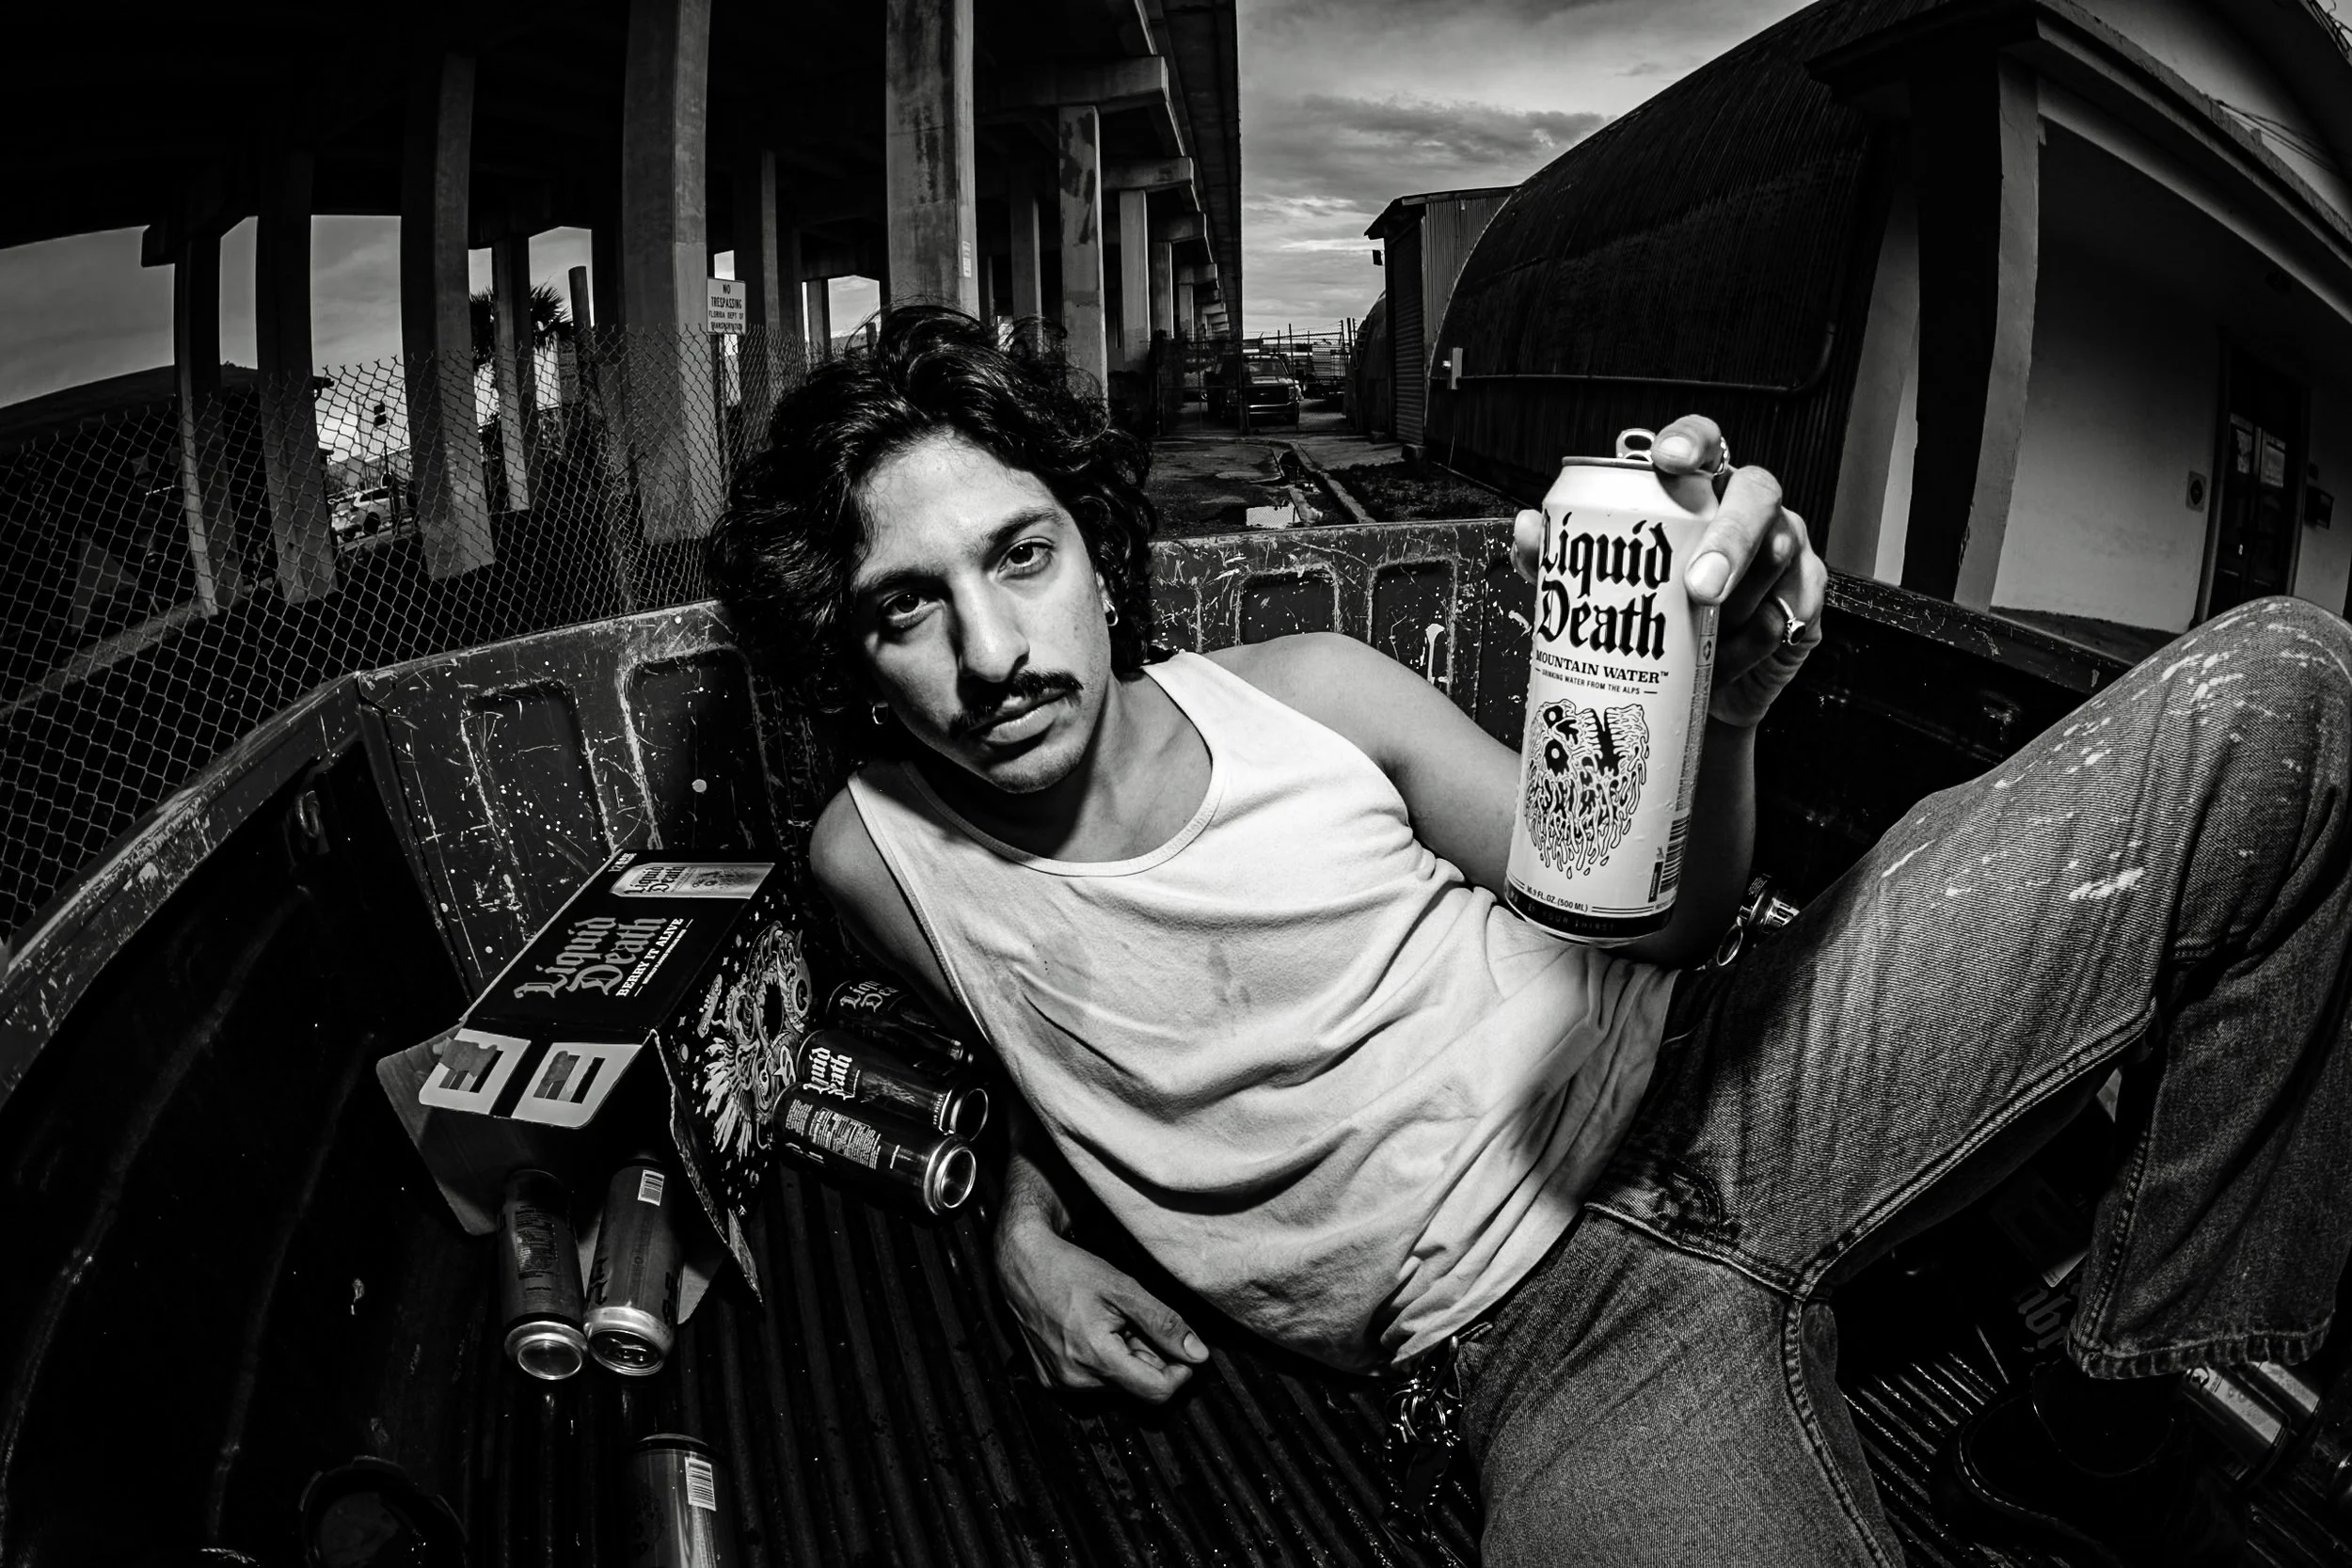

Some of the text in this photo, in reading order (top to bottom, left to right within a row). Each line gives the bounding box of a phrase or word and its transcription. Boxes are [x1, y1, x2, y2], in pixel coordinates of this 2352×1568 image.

[710, 295, 742, 309] TRESPASSING
[723, 284, 731, 294] NO
[1539, 509, 1673, 599] Liquid
[1536, 576, 1666, 660] Death
[1535, 650, 1599, 676] MOUNTAIN
[1542, 669, 1640, 695] DRINKING WATER FROM THE ALPS
[624, 866, 664, 894] Liquid
[647, 866, 687, 894] Death
[1557, 897, 1574, 910] (500
[1575, 902, 1589, 912] ML)
[513, 916, 617, 1000] Liquid
[564, 917, 668, 996] Death
[615, 961, 650, 997] BERRY
[644, 948, 660, 959] IT
[655, 918, 684, 947] ALIVE
